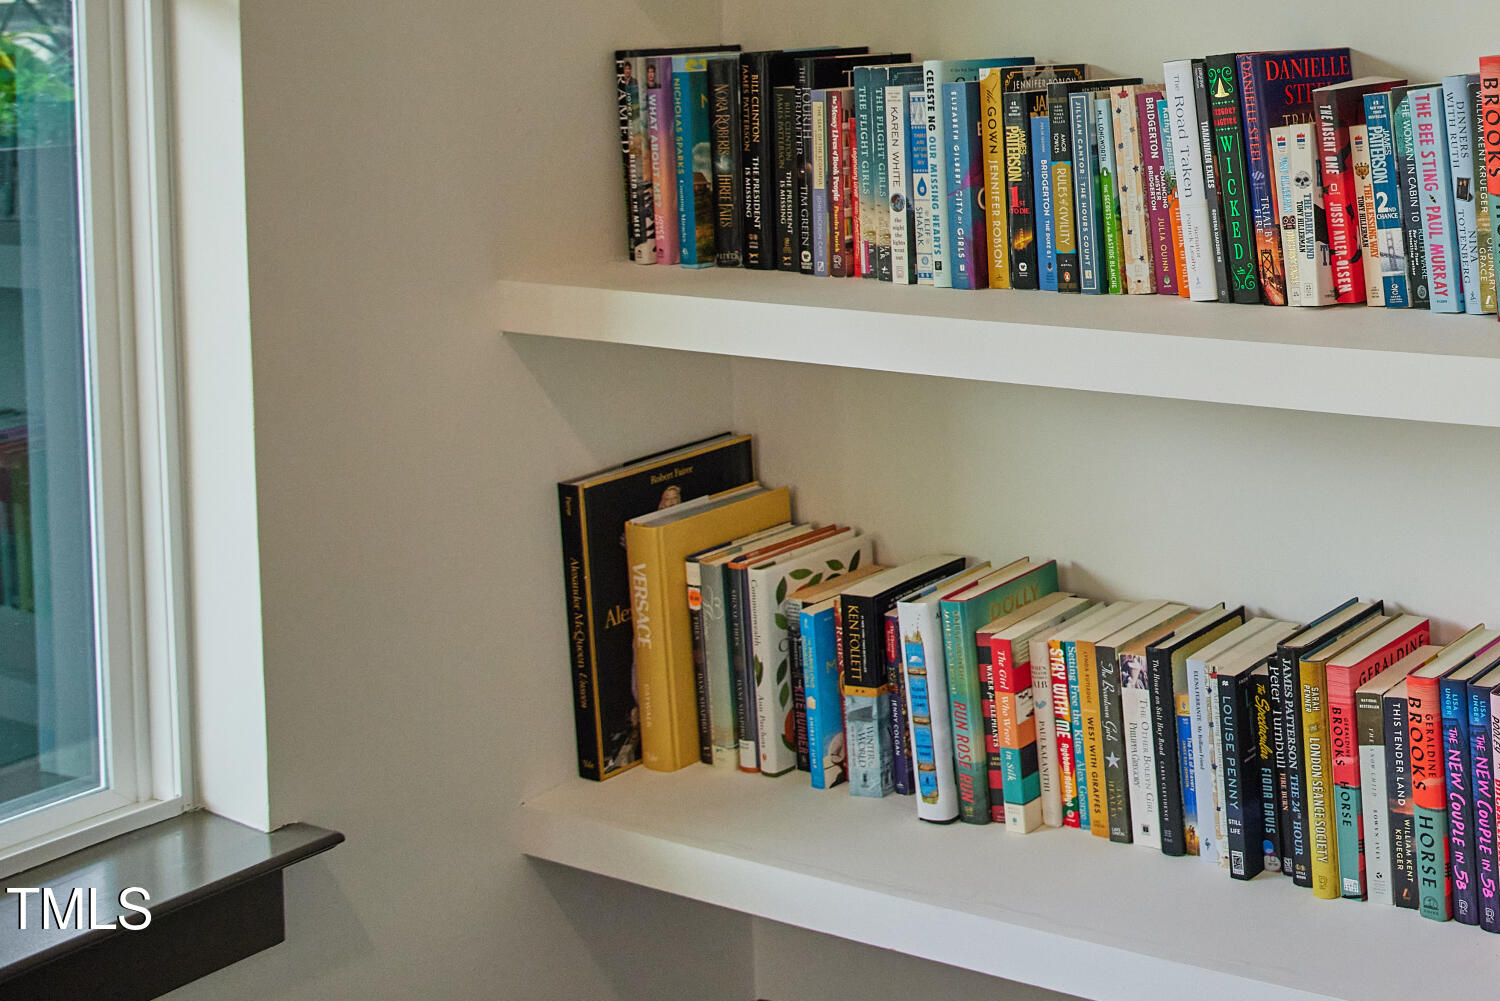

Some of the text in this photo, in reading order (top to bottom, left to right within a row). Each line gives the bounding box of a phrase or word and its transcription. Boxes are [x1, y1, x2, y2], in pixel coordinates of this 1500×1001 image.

[926, 70, 935, 112] CELESTE
[1266, 56, 1348, 81] DANIELLE
[928, 116, 935, 131] NG
[1145, 98, 1159, 159] BRIDGERTON
[930, 163, 938, 210] MISSING
[1220, 136, 1244, 260] WICKED
[1415, 93, 1448, 296] THE BEE STING PAUL MURRAY
[932, 213, 941, 255] HEARTS
[631, 563, 650, 649] VERSACE
[848, 606, 861, 682] KEN FOLLETT
[953, 701, 974, 802] RUN ROSE RUN
[1222, 696, 1239, 809] LOUISE PENNY
[1392, 703, 1406, 806] THIS TENDER LAND
